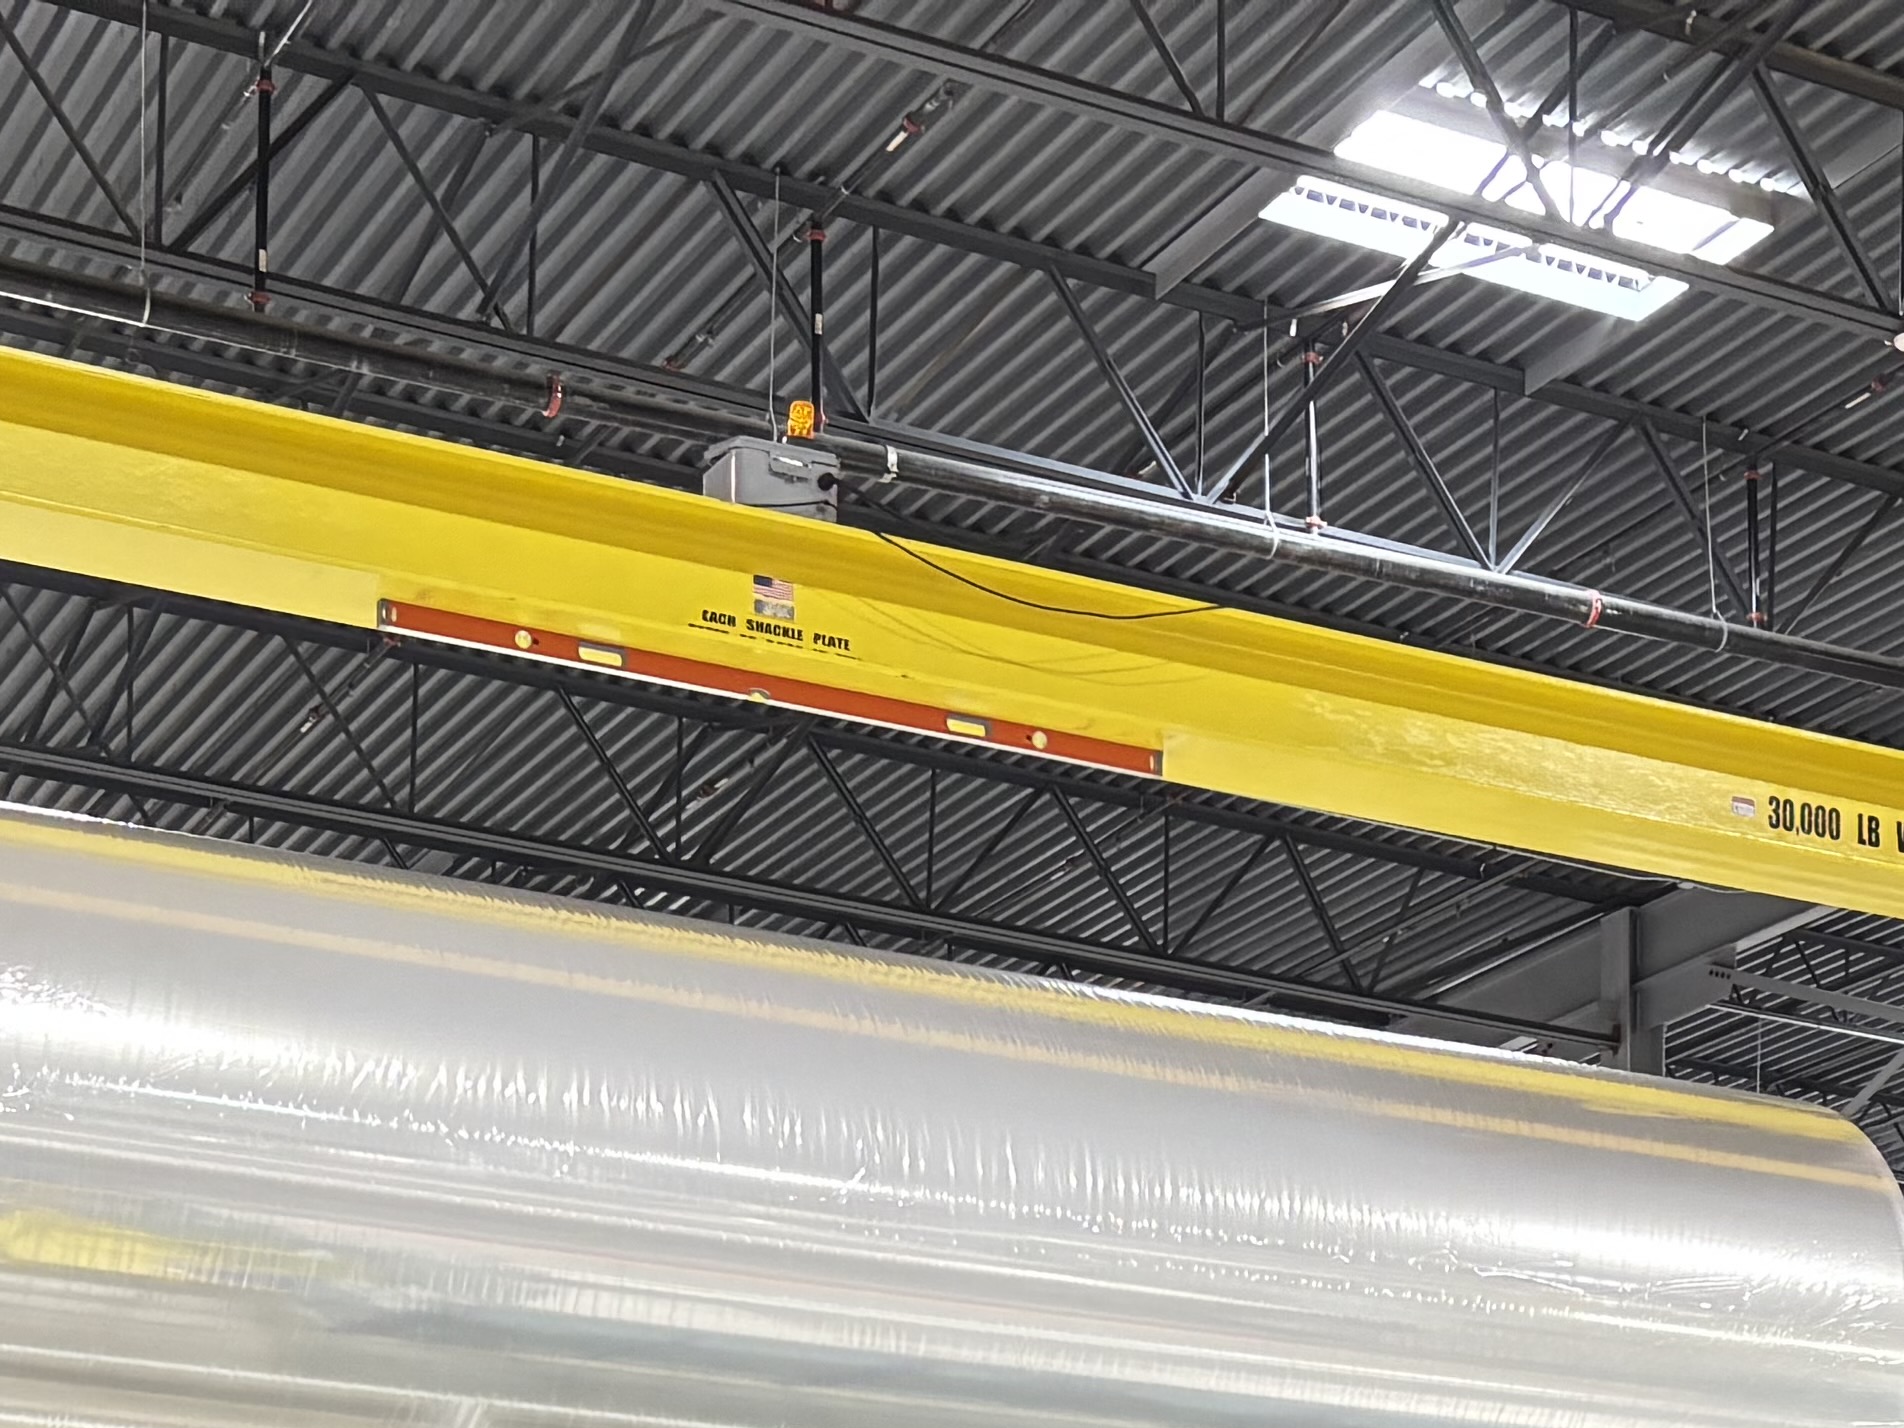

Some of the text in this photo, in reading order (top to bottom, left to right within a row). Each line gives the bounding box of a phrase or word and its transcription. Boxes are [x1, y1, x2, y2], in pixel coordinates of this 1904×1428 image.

[745, 618, 804, 642] SHACKLE
[813, 632, 851, 651] PLATE
[1767, 795, 1842, 841] 30,000
[1856, 813, 1881, 848] LB
